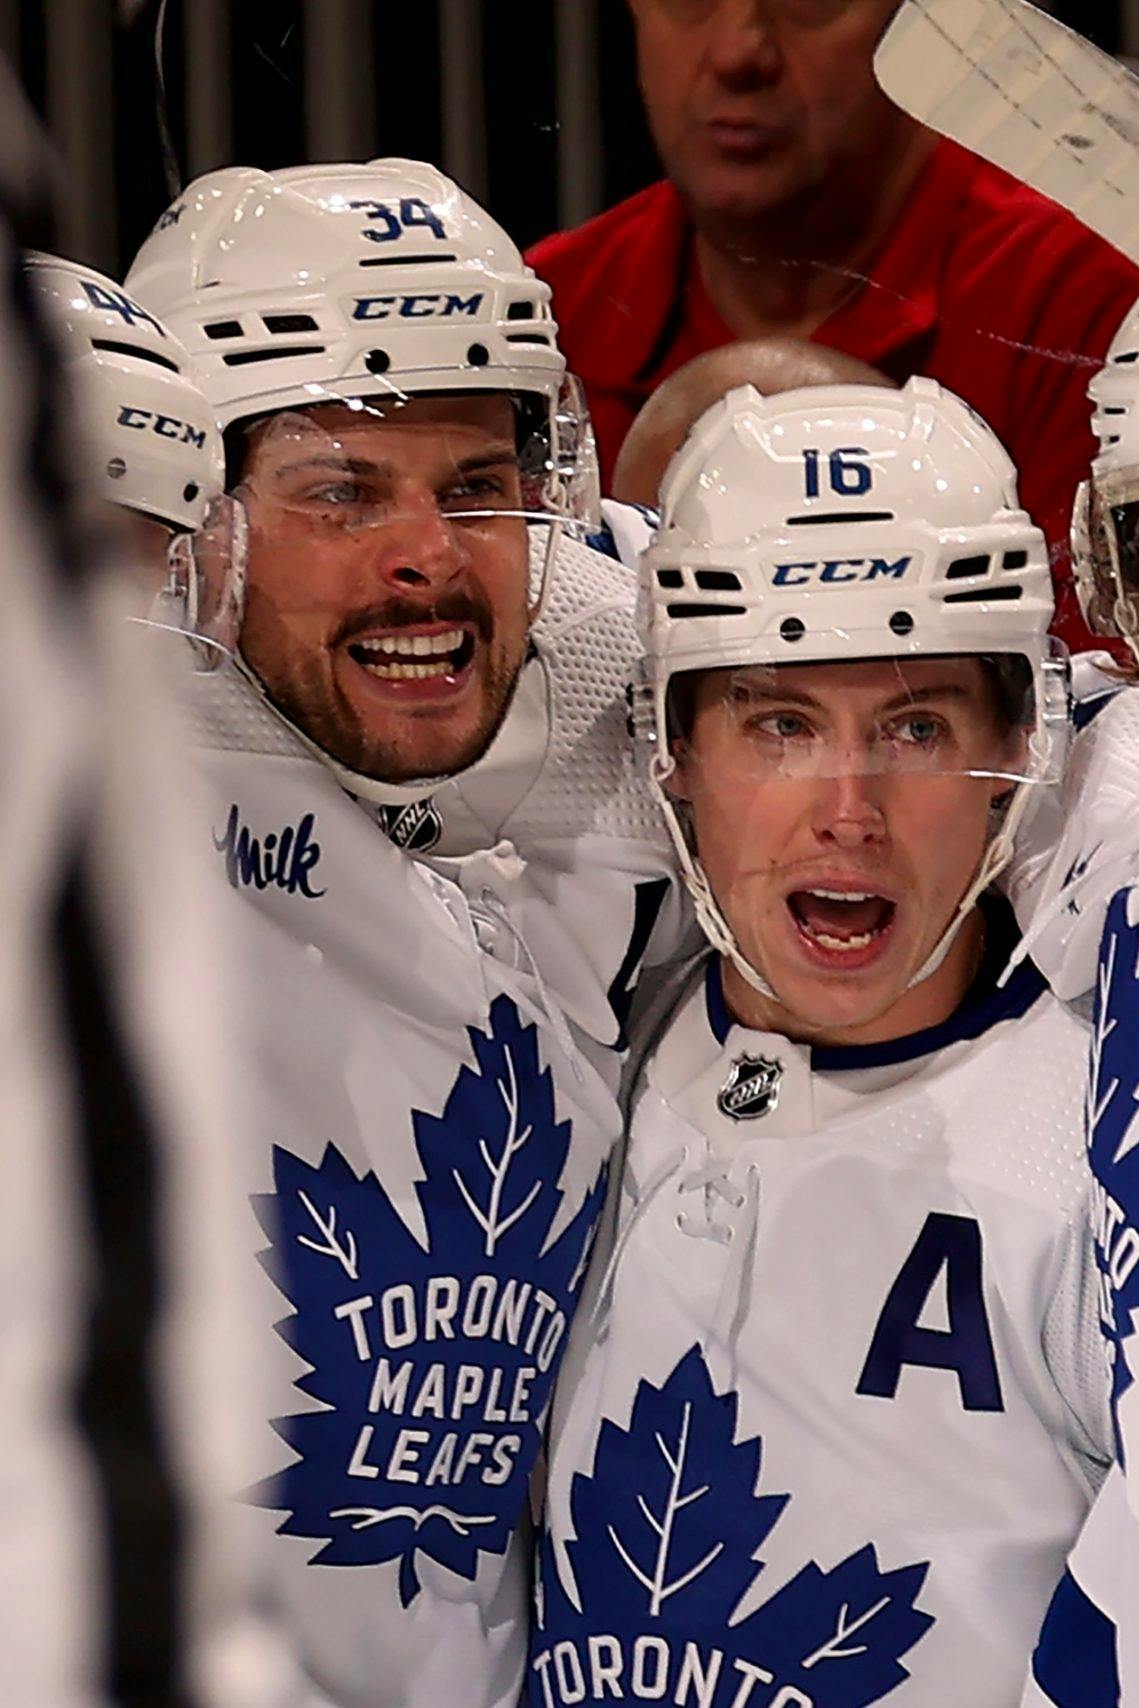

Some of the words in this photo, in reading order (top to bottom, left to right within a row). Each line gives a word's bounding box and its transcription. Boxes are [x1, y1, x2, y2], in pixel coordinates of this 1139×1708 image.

[347, 198, 448, 243] 34
[80, 279, 168, 338] 44
[351, 292, 485, 321] CCM
[116, 404, 207, 450] CCM
[801, 446, 873, 498] 16
[771, 556, 913, 587] CCM
[395, 801, 427, 845] NHL
[212, 803, 328, 899] Milk
[333, 1274, 567, 1373] TORONTO
[855, 1211, 1006, 1414] A
[367, 1357, 537, 1423] MAPLE
[346, 1424, 522, 1487] LEAFS
